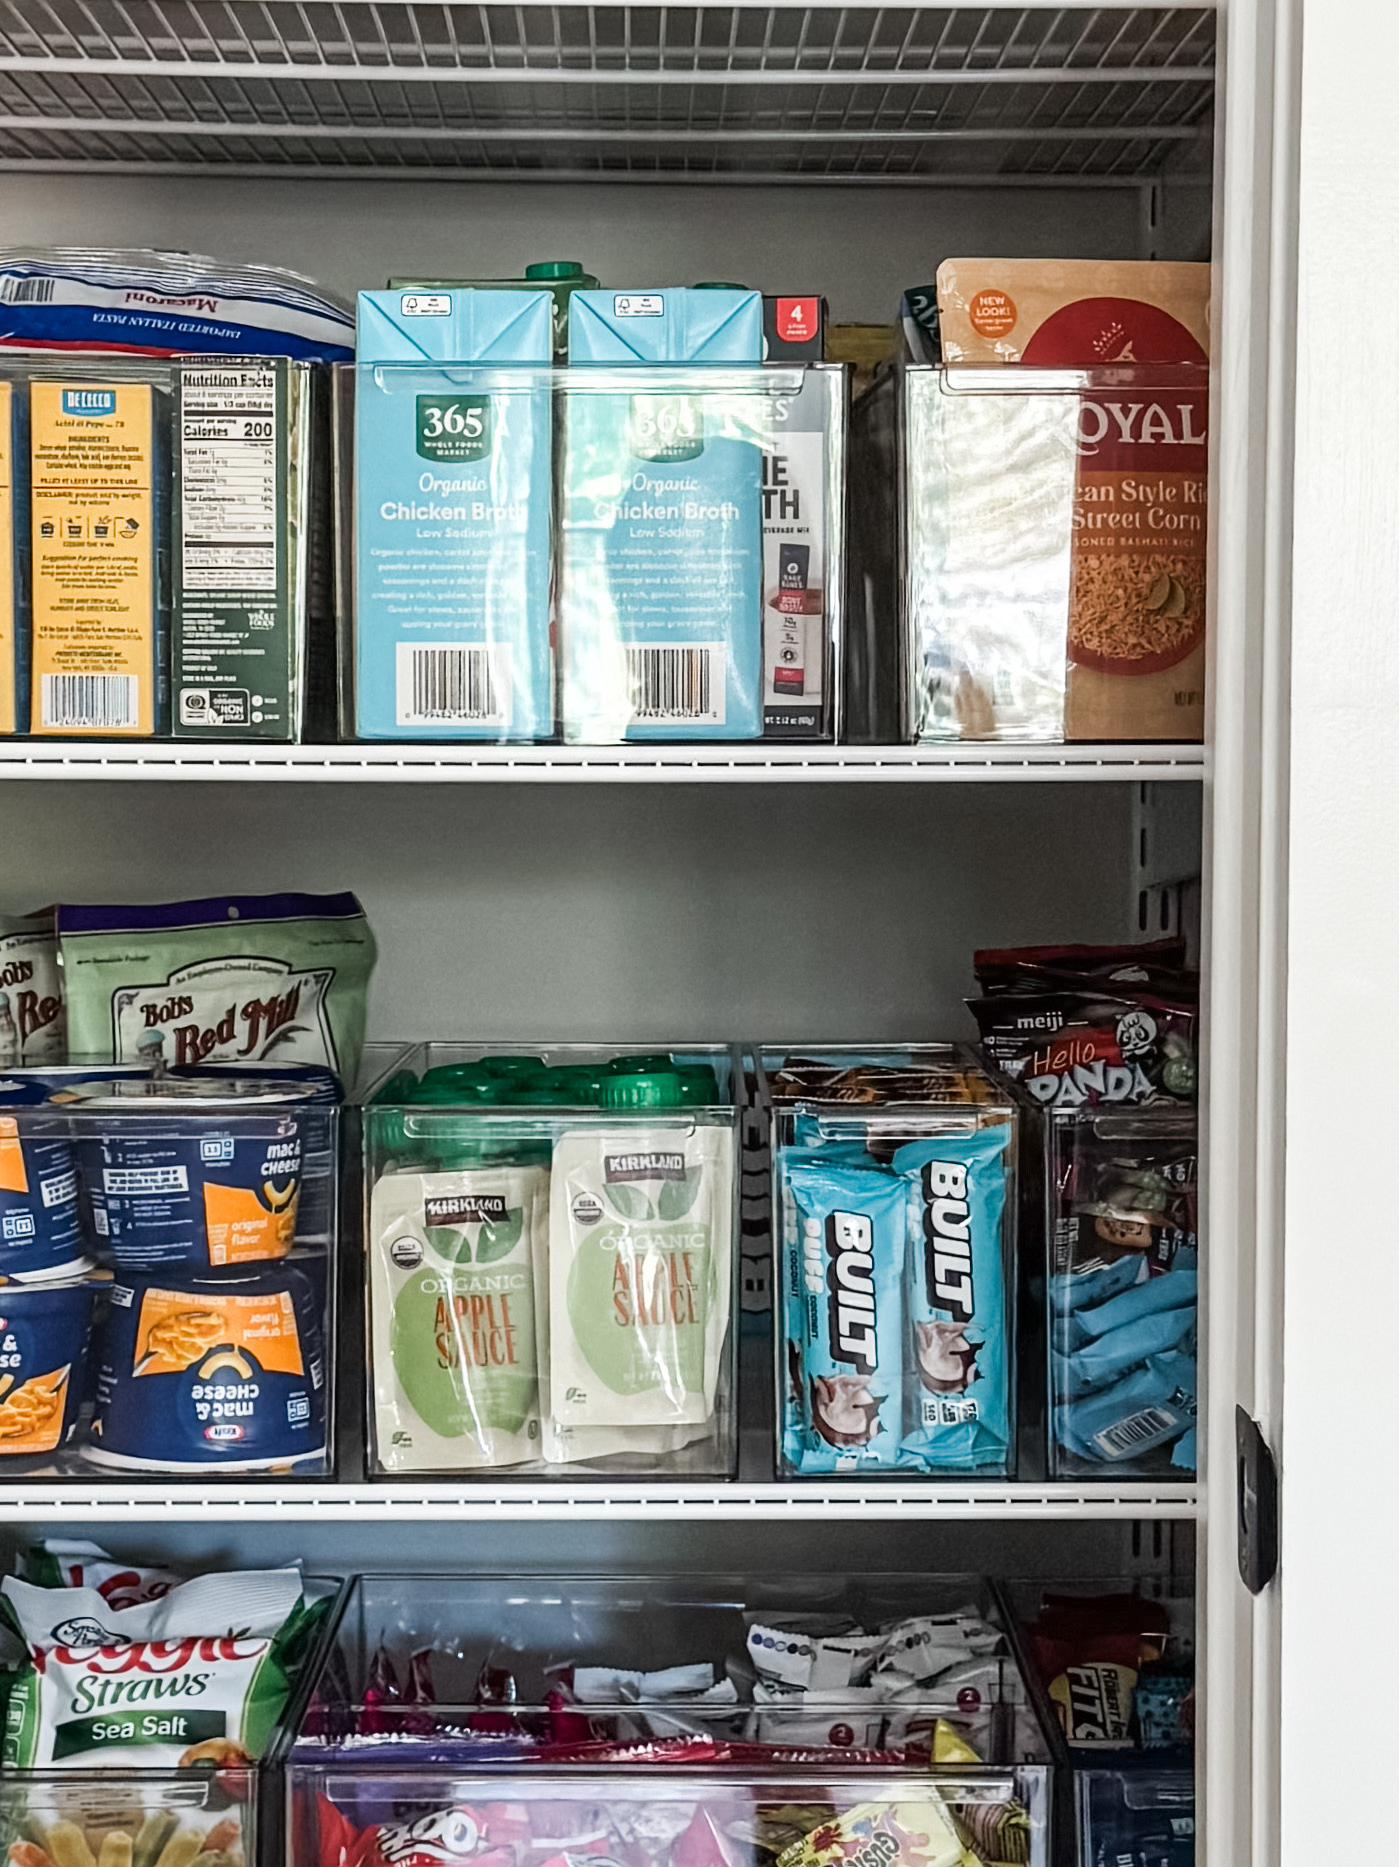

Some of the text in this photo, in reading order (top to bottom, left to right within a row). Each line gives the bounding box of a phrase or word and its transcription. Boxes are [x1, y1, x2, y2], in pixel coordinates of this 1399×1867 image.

[125, 291, 218, 314] Macaroni
[976, 307, 1010, 316] LOOK!
[980, 297, 1005, 306] NEW
[790, 305, 803, 322] 4
[92, 312, 241, 340] IMPORTED ITALIAN PASTA
[184, 374, 273, 388] Nutrition Fcts
[184, 423, 272, 437] Calories 200
[423, 404, 483, 438] 365
[1078, 401, 1206, 456] OYAL
[419, 472, 487, 497] Organic
[633, 472, 698, 497] Organic
[1122, 479, 1177, 507] Style
[380, 501, 527, 521] Chicken Broth
[594, 501, 740, 521] Chicken Broth
[1072, 507, 1201, 531] Street Corn
[416, 527, 442, 538] Low
[629, 527, 655, 538] Low
[17, 990, 62, 1041] Re
[140, 995, 194, 1027] Bob's
[173, 979, 302, 1064] Red Mill
[1017, 1011, 1064, 1032] meiji
[1034, 1041, 1095, 1075] Hello
[1025, 1060, 1156, 1107] PANDA
[267, 1144, 300, 1160] mac &
[610, 1153, 683, 1172] KIRKLAND
[428, 1197, 503, 1216] KIRKLAND
[599, 1233, 706, 1251] ORGANIC
[929, 1161, 973, 1320] BUILT
[420, 1274, 527, 1295] ORGANIC
[833, 1211, 878, 1370] BUILT
[434, 1293, 515, 1333] APPLE
[614, 1288, 701, 1327] SAUCE
[3, 1336, 17, 1352] &
[436, 1329, 520, 1369] SAUCE
[195, 1401, 254, 1420] mac &
[70, 1675, 211, 1714] Straws
[1067, 1667, 1103, 1723] FIT
[92, 1717, 187, 1740] Sea Salt
